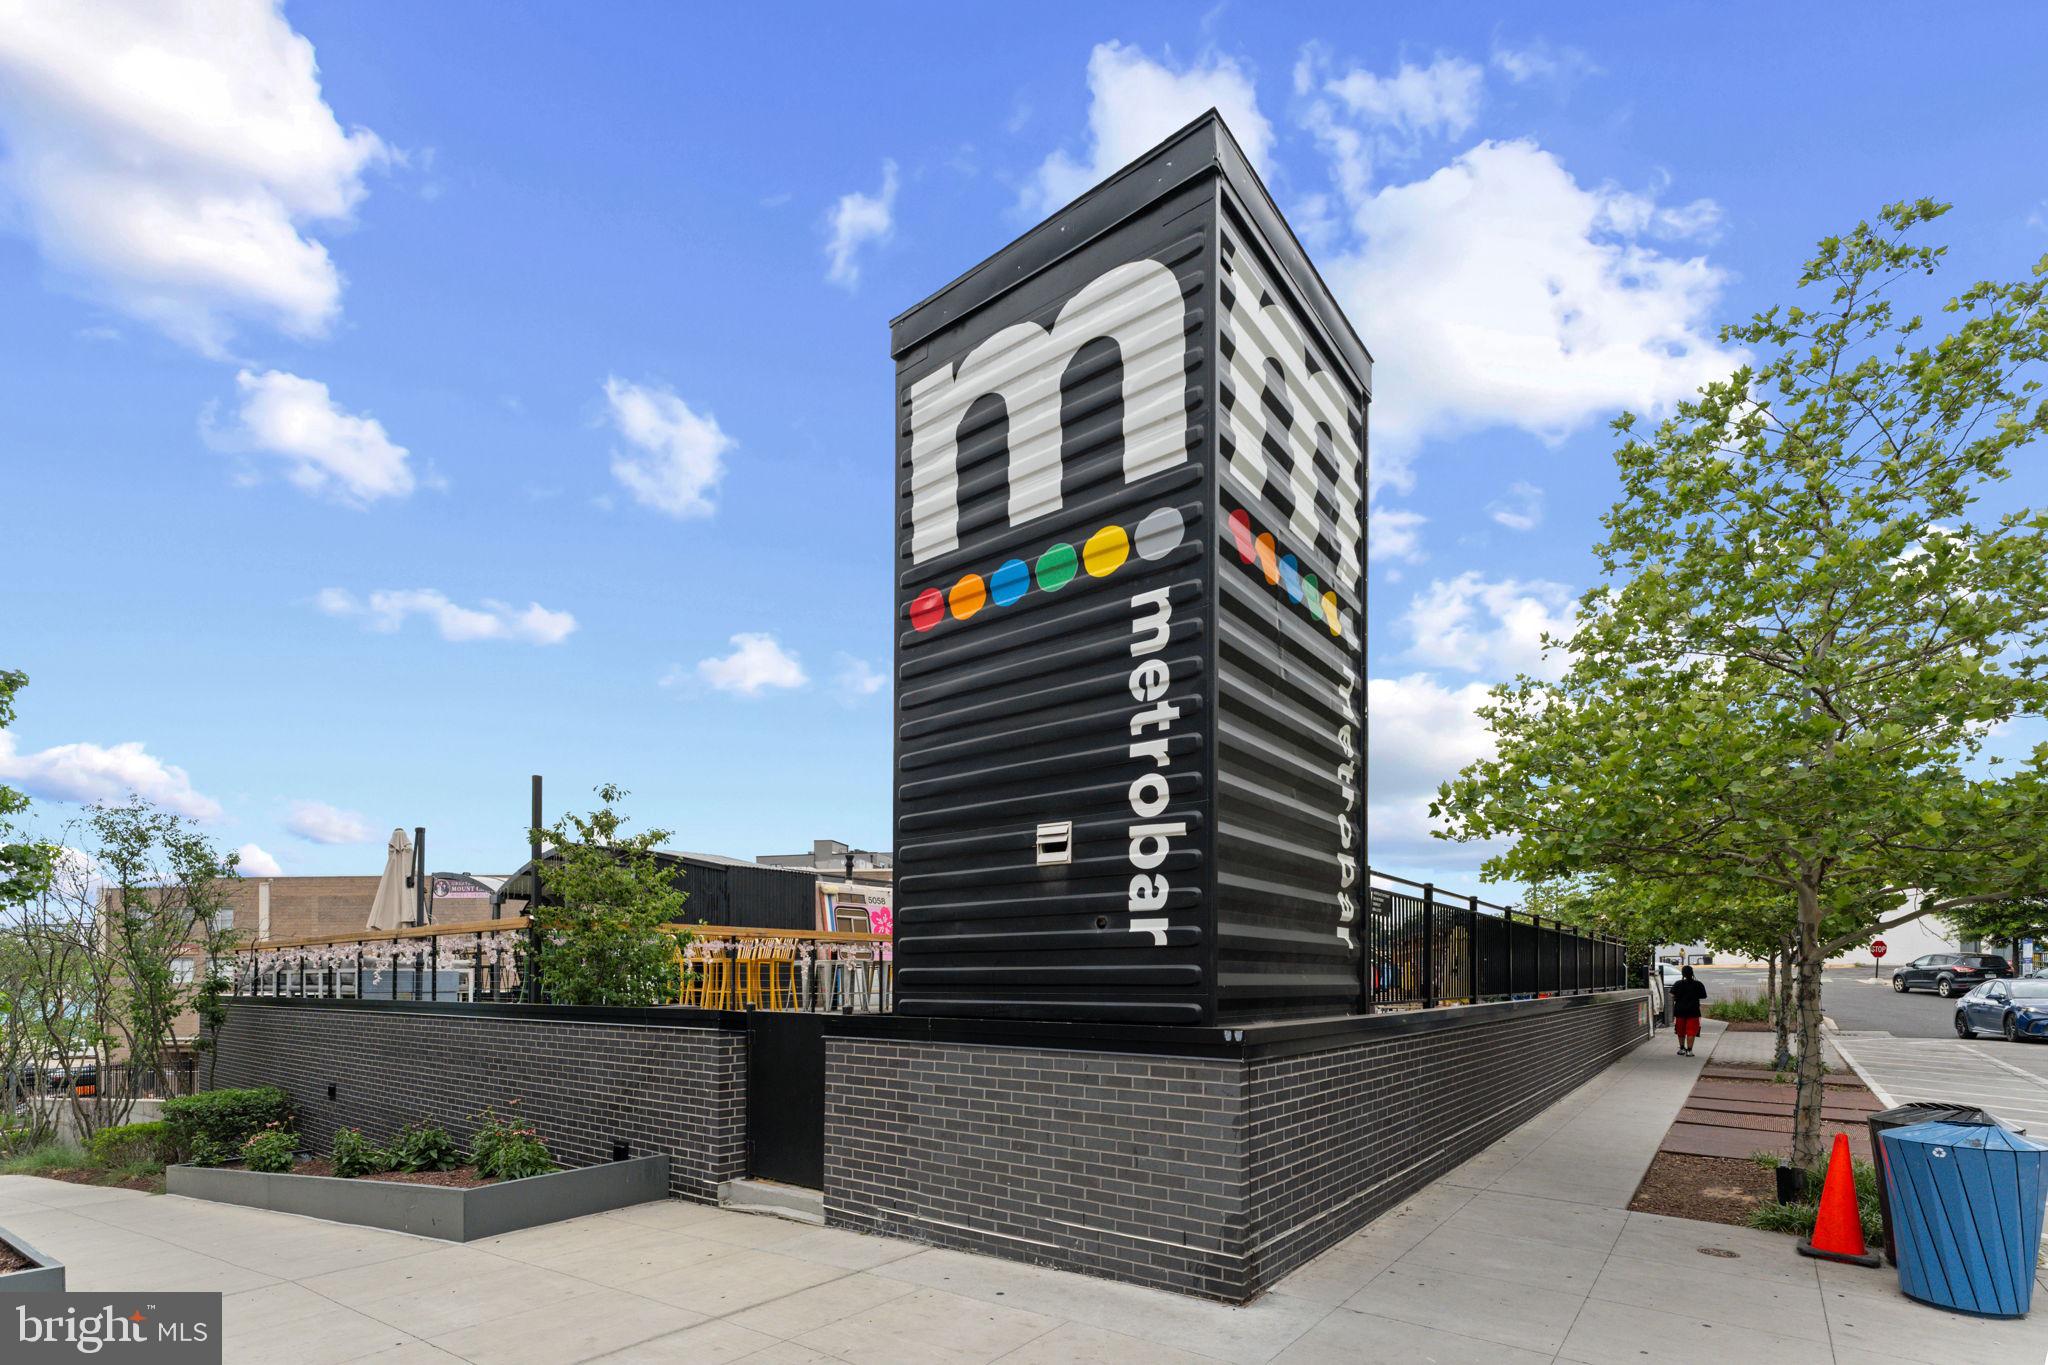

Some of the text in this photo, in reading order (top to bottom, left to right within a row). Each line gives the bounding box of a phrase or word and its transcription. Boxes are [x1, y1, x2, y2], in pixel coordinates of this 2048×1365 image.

[911, 259, 1188, 565] m
[1230, 248, 1361, 591] m
[868, 896, 886, 905] 5058
[1129, 586, 1187, 946] metrobar
[1337, 665, 1356, 950] metrobar
[1871, 945, 1886, 953] STOP
